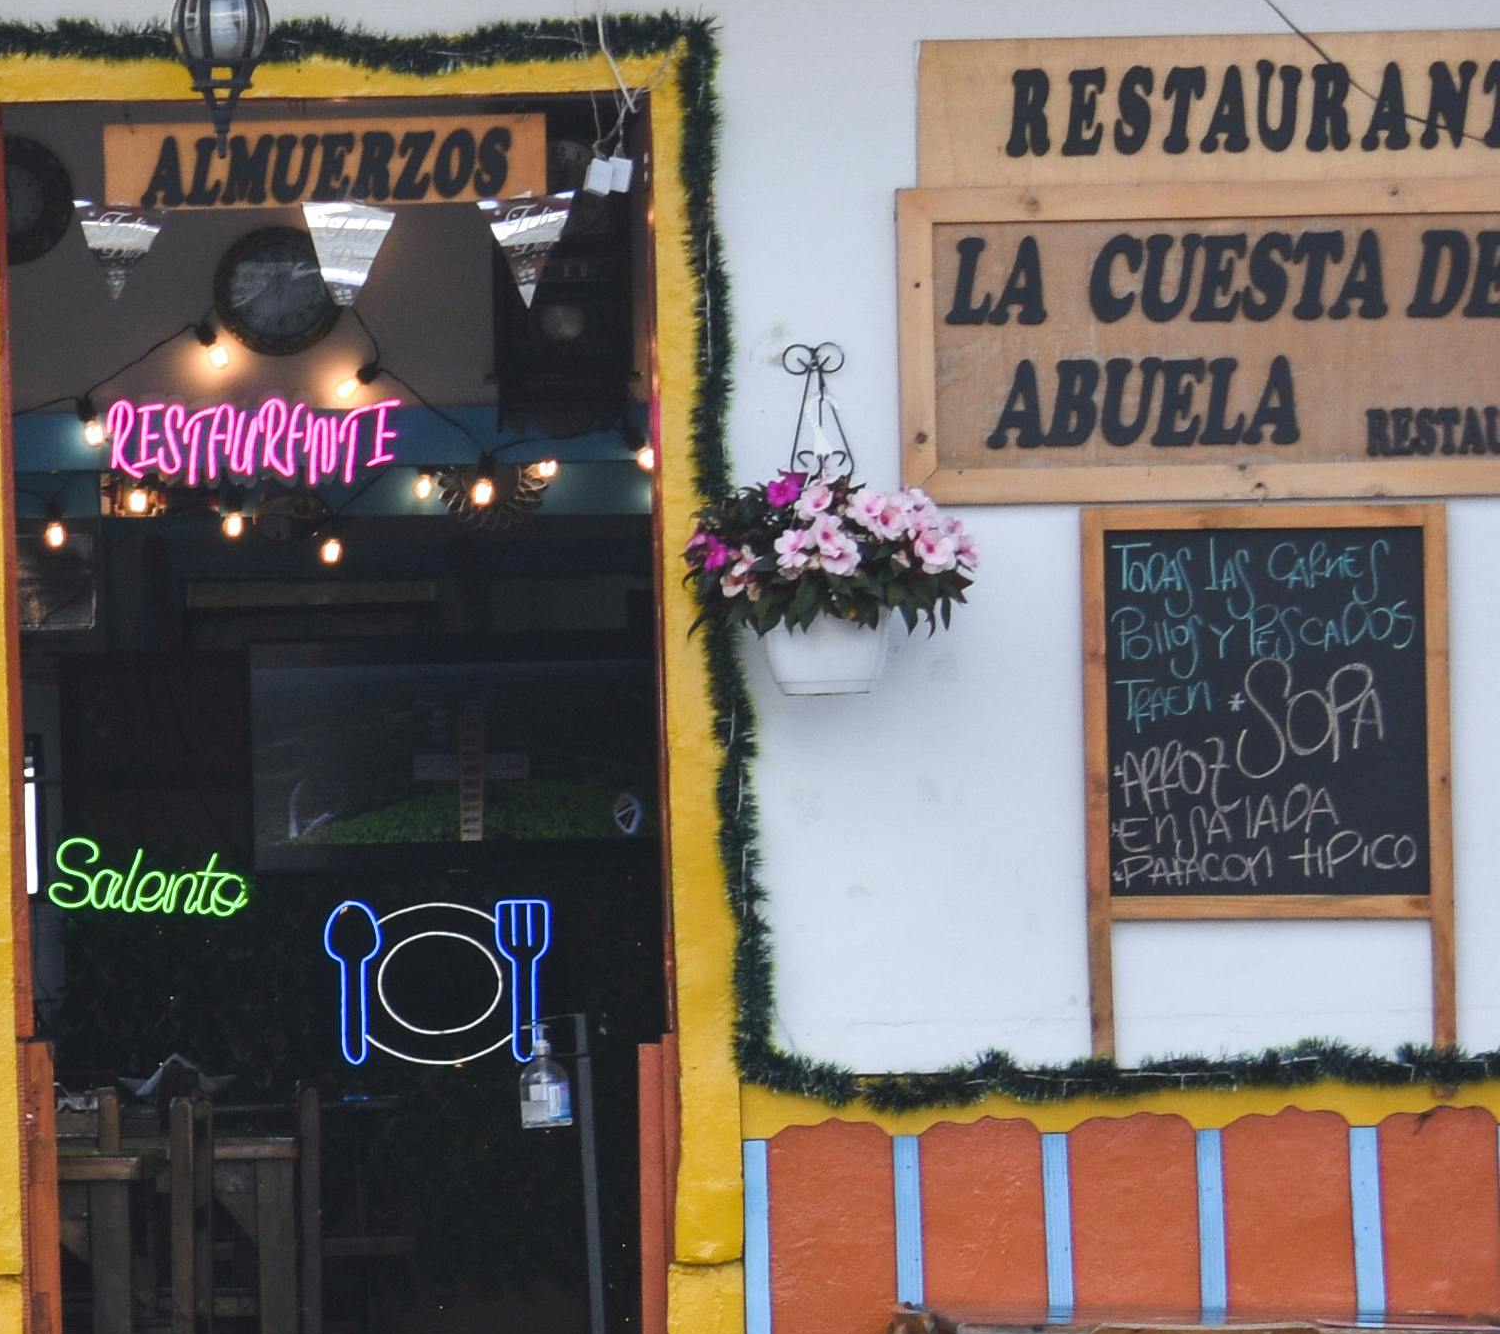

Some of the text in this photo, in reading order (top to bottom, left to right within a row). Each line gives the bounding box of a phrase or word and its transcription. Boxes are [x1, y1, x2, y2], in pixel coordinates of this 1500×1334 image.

[140, 127, 512, 207] ALMUERZOS
[945, 229, 1500, 326] LA CUESTA DE
[107, 398, 401, 486] RESTAURANTE
[986, 355, 1301, 448] ABUELA
[1209, 624, 1234, 659] Y
[48, 837, 249, 917] Salento
